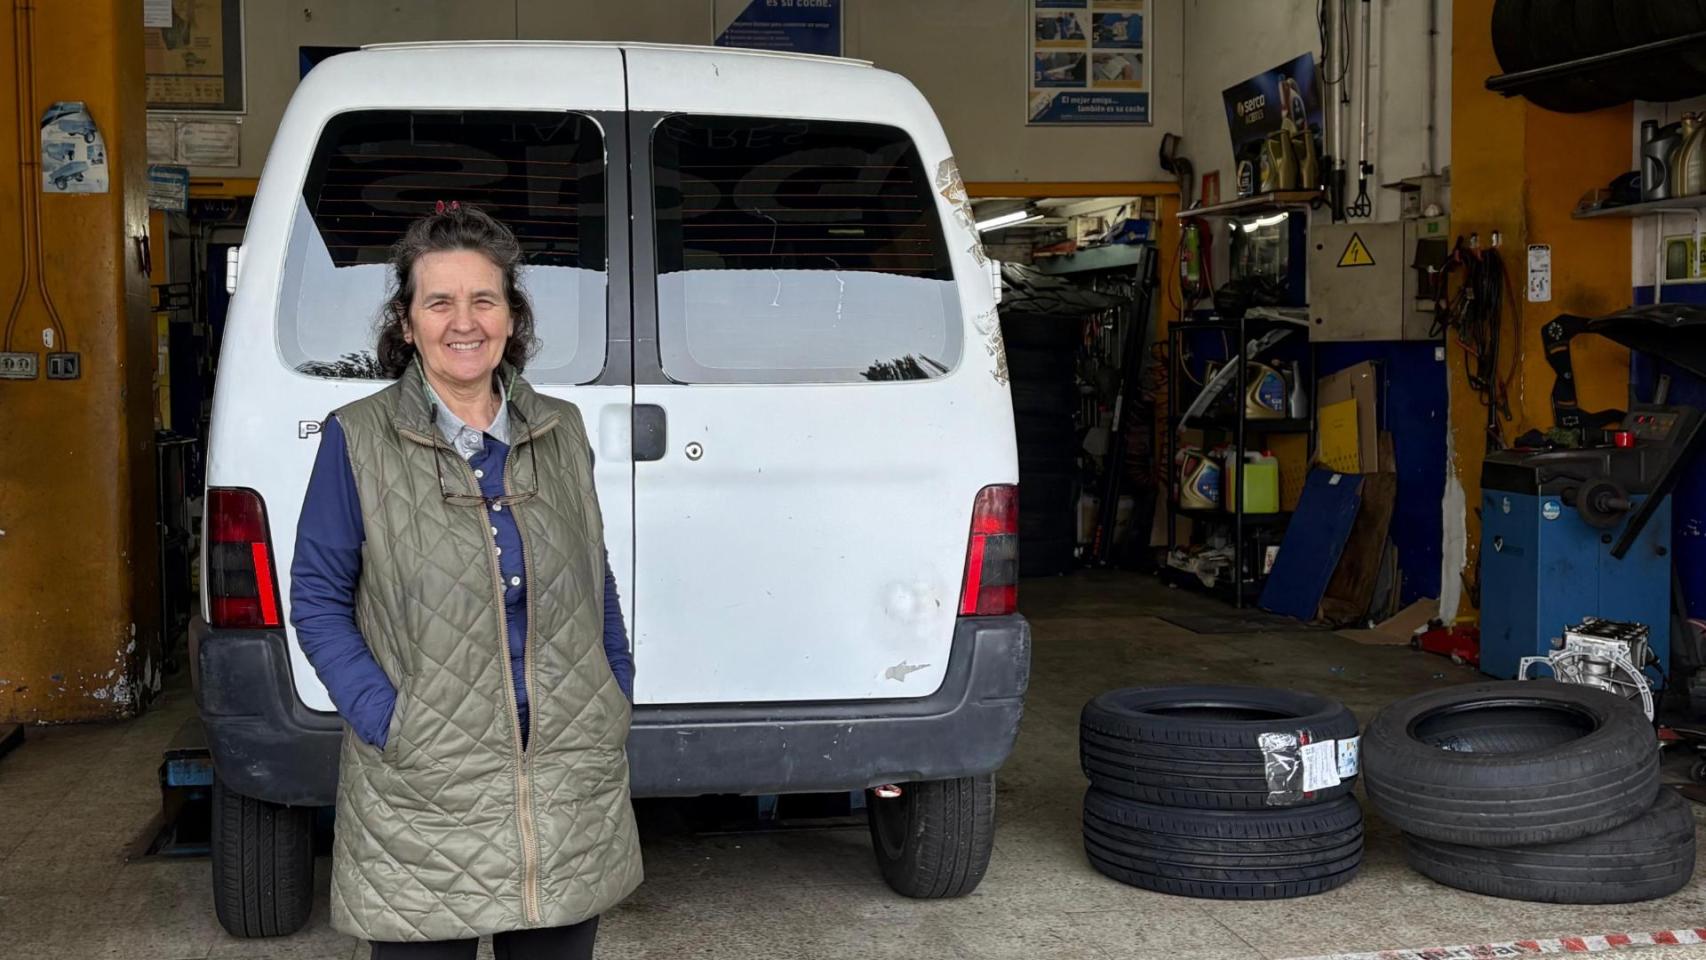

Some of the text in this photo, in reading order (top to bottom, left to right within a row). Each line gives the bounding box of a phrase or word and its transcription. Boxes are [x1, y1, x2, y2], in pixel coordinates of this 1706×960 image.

[1061, 96, 1069, 104] El
[1070, 96, 1090, 105] mejor
[1243, 94, 1265, 113] serco
[298, 420, 322, 439] P
